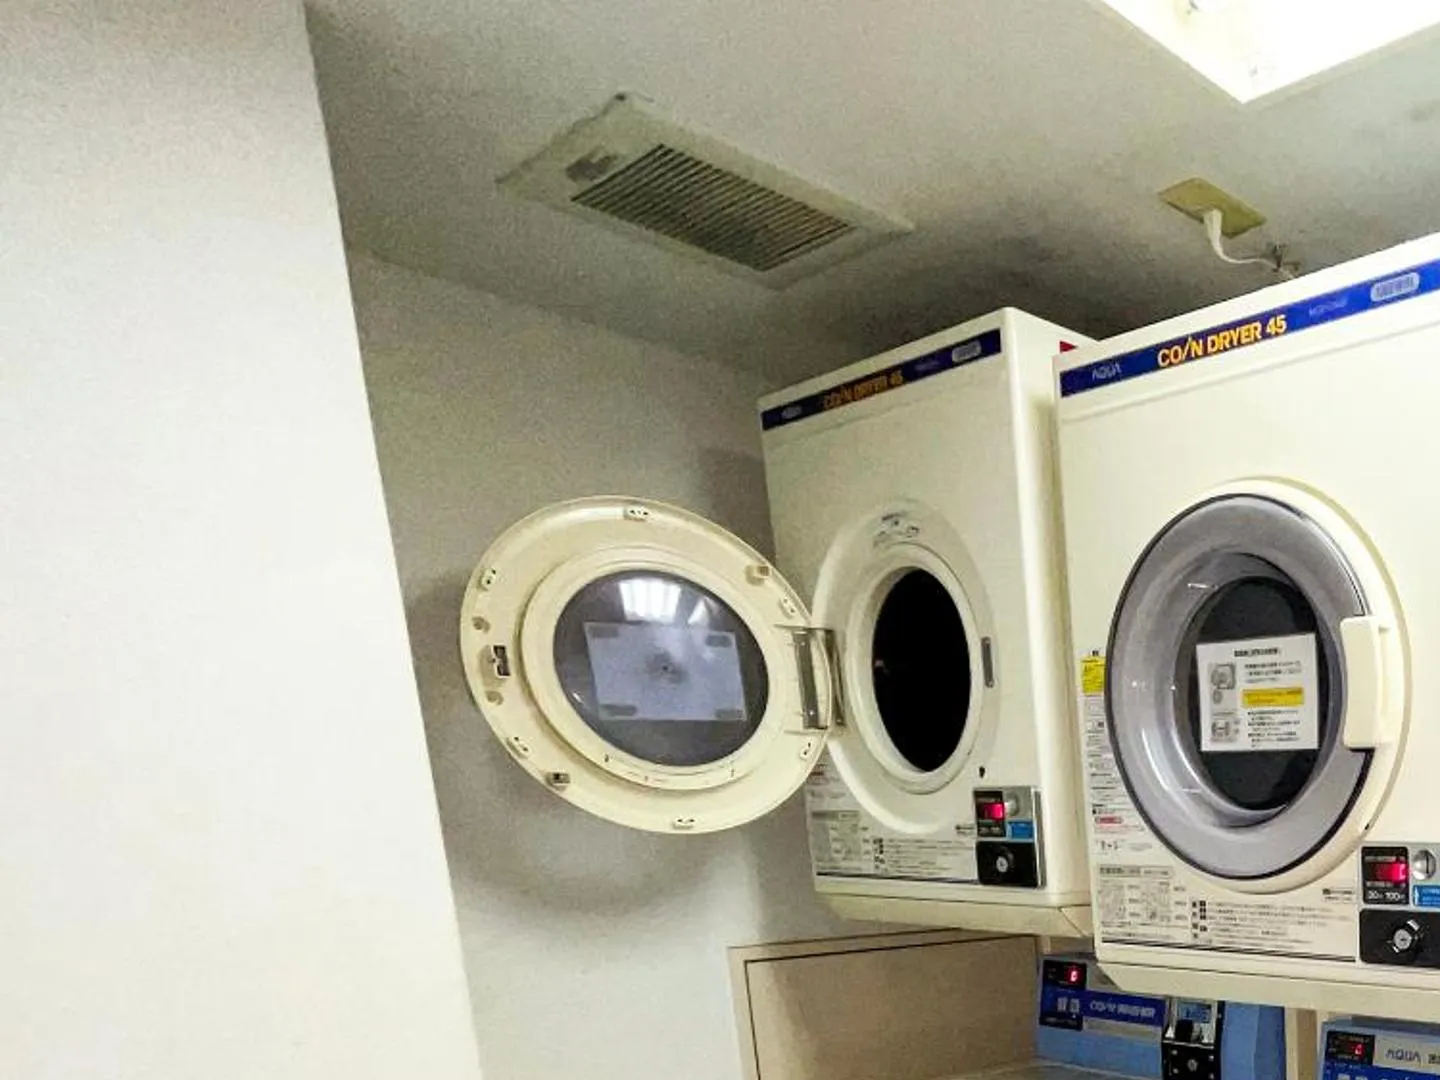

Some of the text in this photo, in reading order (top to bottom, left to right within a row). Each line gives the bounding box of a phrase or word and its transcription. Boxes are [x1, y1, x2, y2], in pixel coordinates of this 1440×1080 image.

[1207, 323, 1262, 353] DRYER
[1266, 314, 1288, 335] 45
[1385, 1048, 1422, 1064] AQUA
